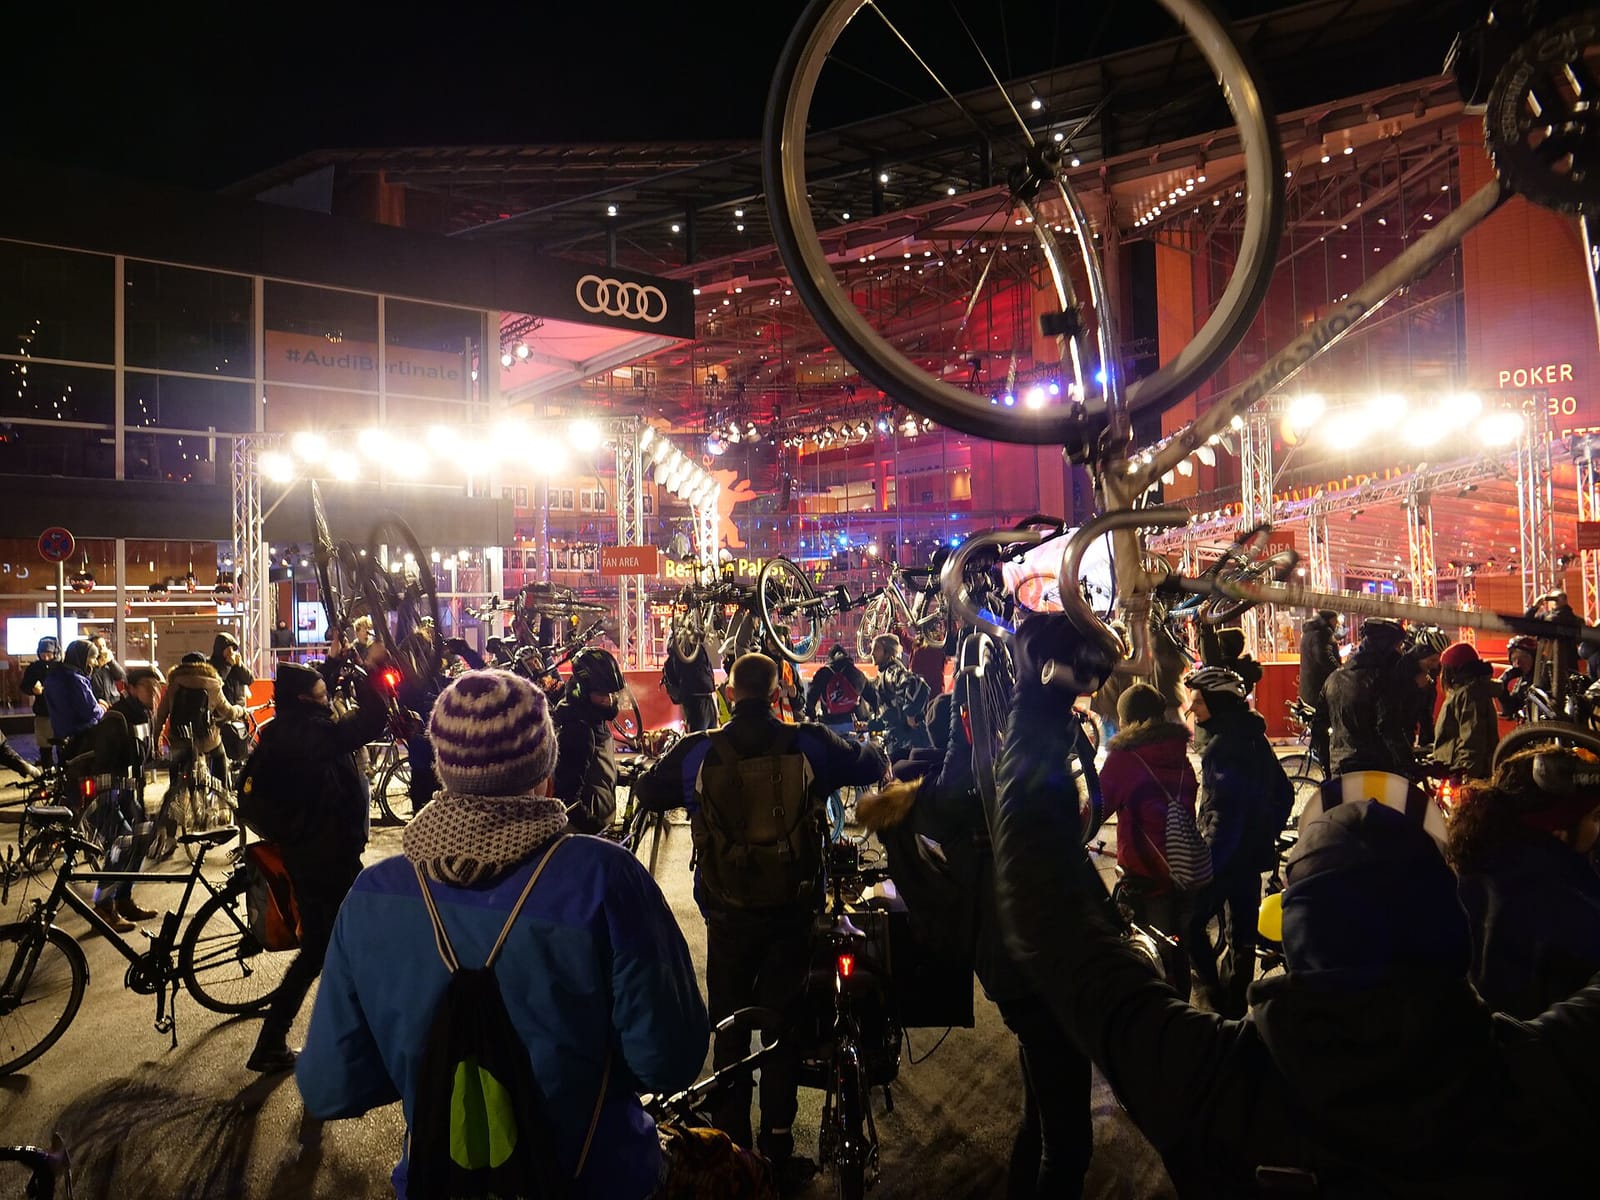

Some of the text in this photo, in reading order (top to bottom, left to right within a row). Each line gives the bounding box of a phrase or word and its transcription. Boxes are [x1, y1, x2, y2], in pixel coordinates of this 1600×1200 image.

[1499, 363, 1574, 388] POKER
[602, 556, 640, 568] FAN AREA
